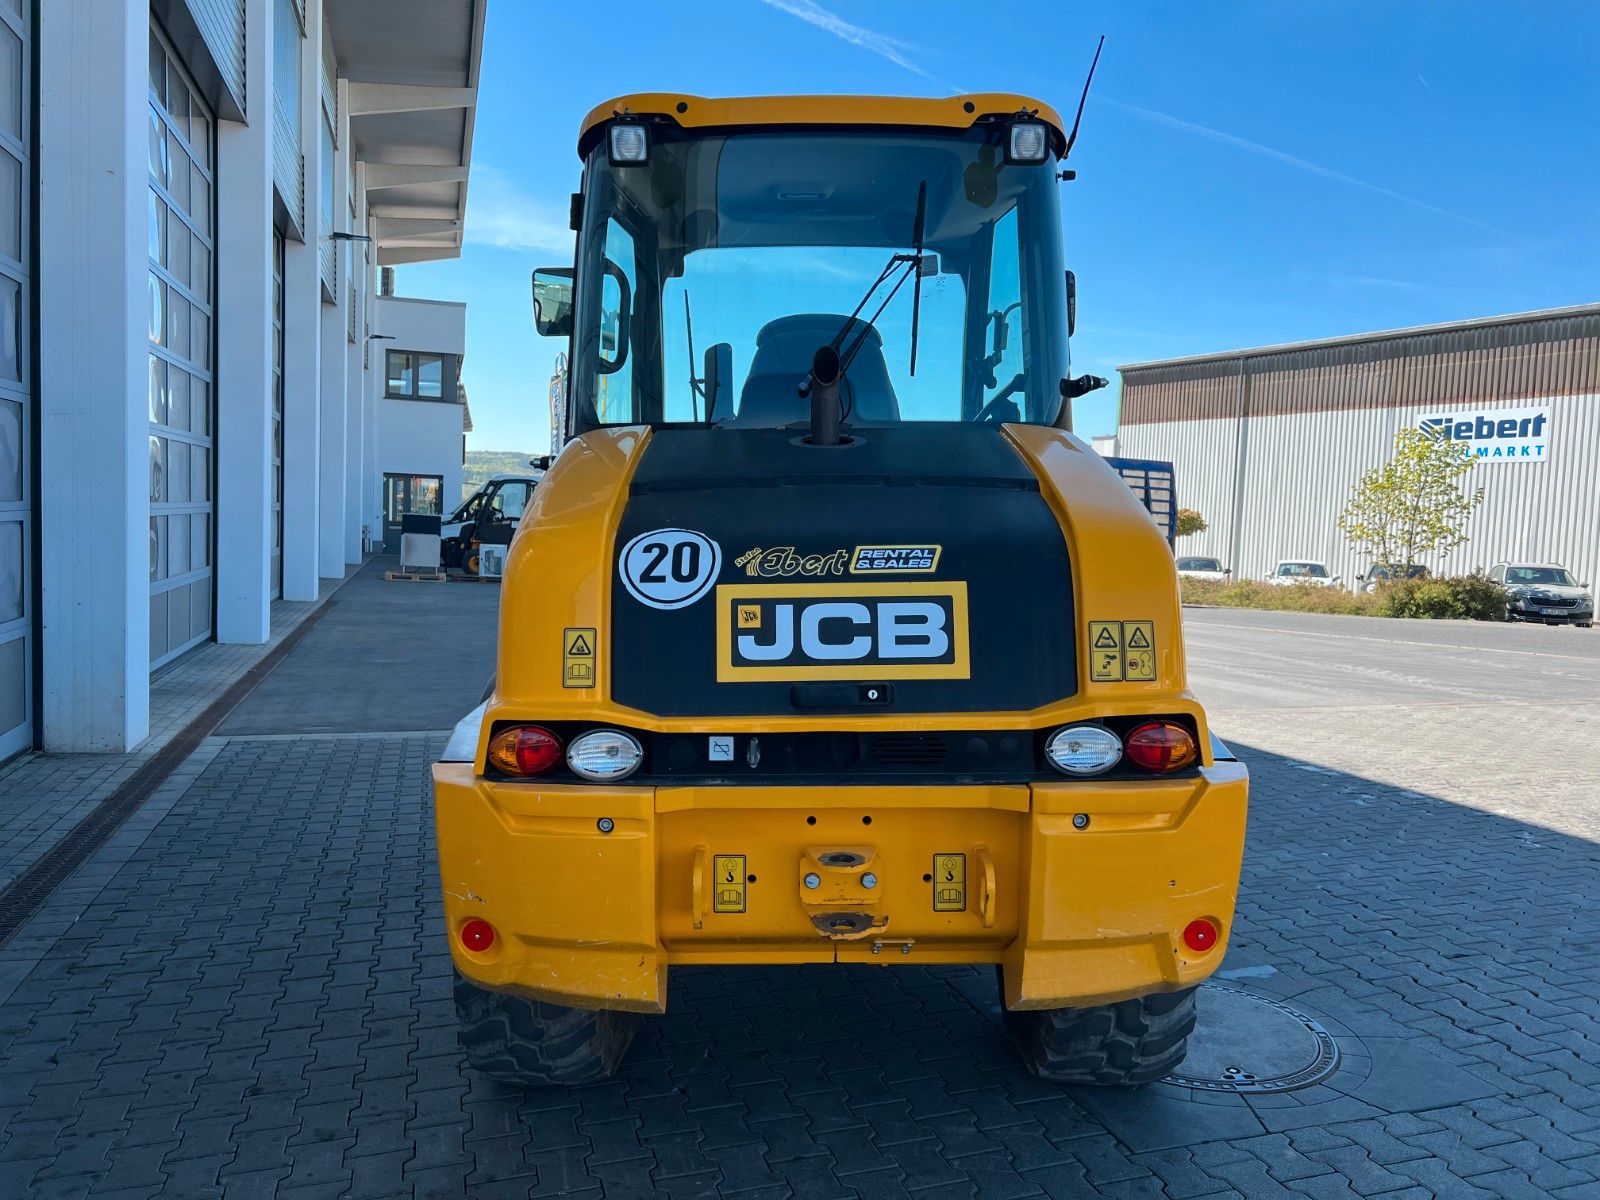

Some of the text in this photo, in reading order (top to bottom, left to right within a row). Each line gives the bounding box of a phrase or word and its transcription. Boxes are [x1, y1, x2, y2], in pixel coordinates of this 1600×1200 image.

[639, 541, 700, 583] 20
[735, 546, 849, 577] Stefan Ebert
[855, 559, 932, 569] & SALES
[859, 549, 934, 559] RENTAL
[737, 602, 949, 660] JCB
